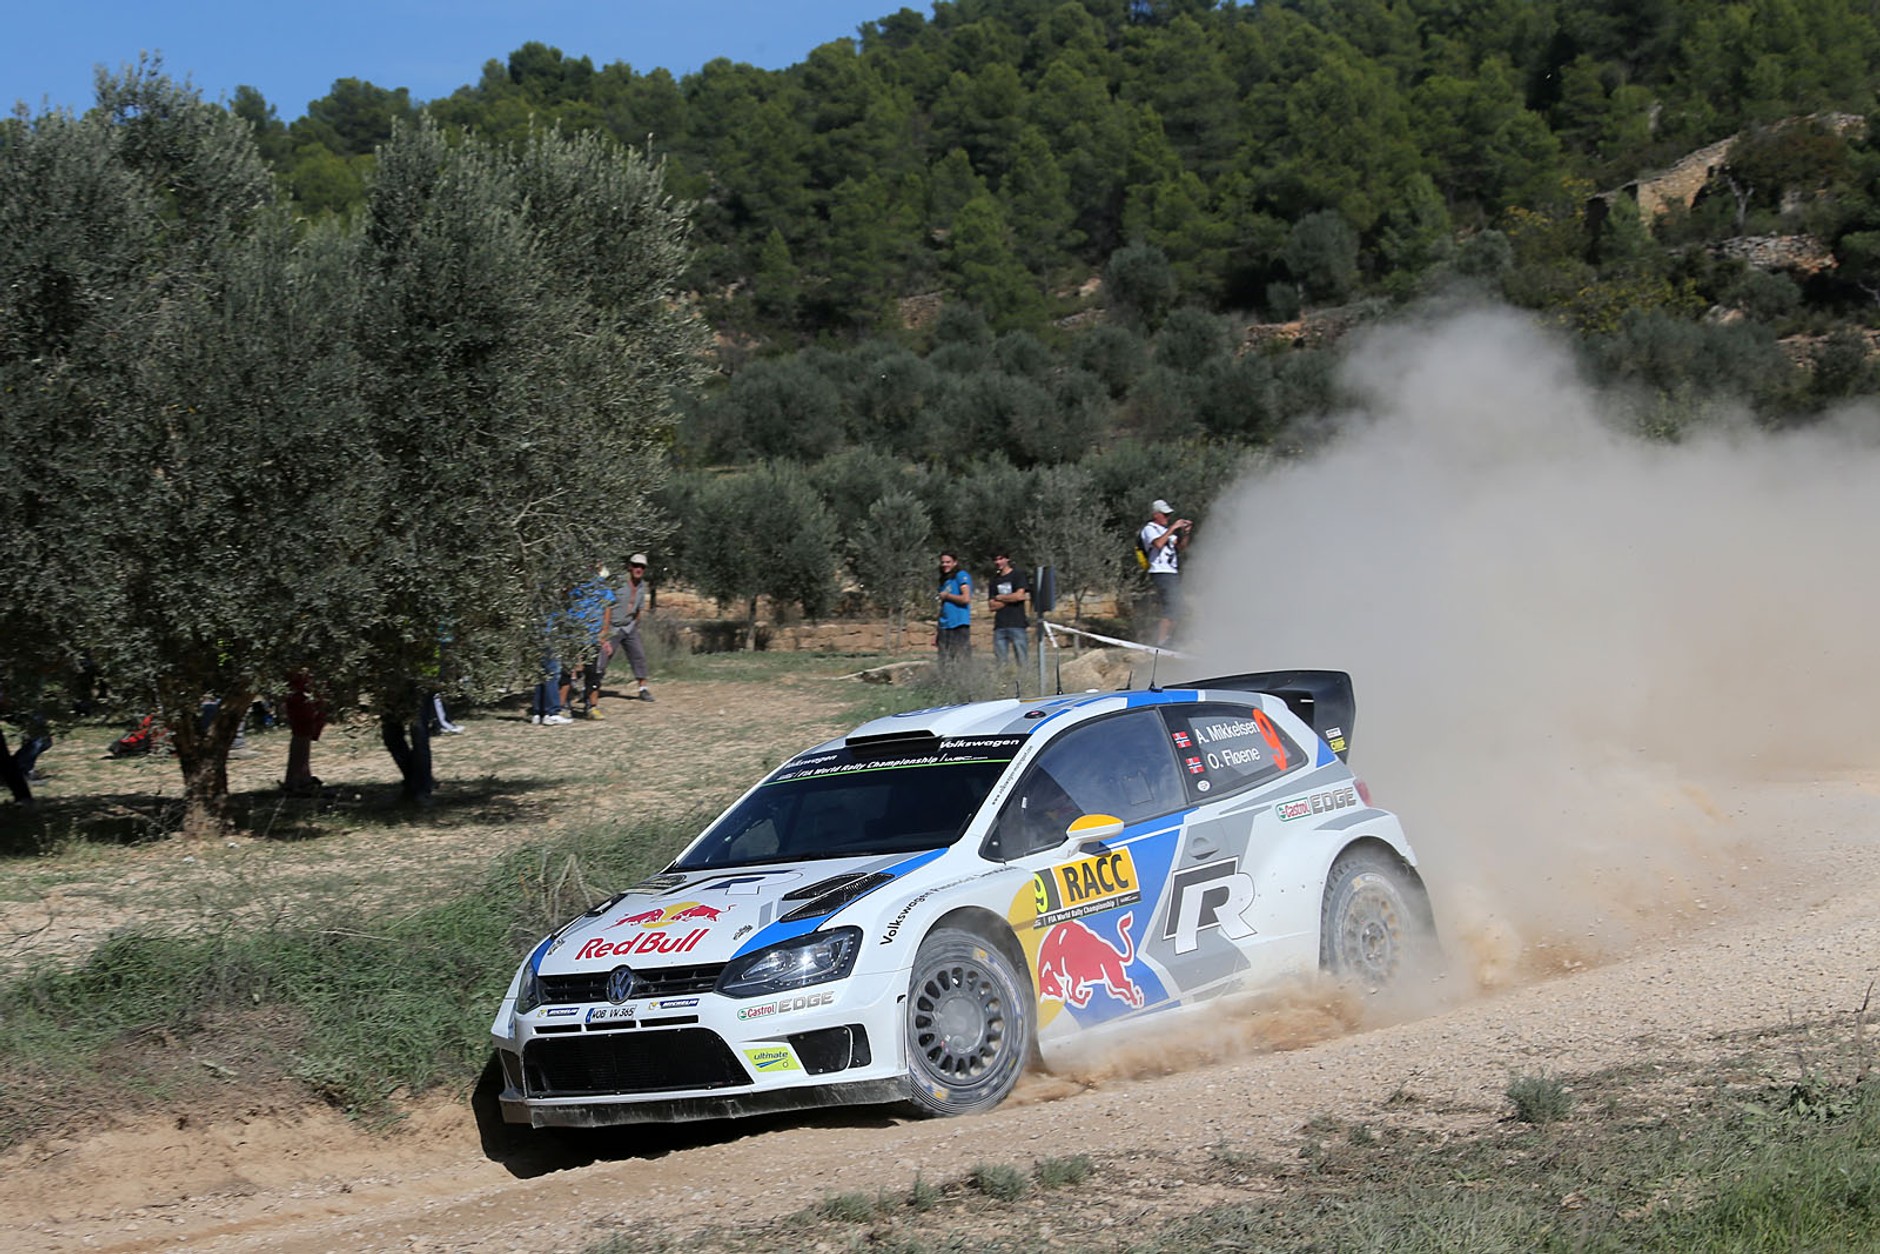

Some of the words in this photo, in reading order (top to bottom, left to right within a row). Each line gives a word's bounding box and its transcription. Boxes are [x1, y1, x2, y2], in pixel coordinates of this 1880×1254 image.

[940, 739, 1020, 750] Volkswagen
[1194, 728, 1210, 744] A.
[1206, 721, 1261, 742] Mikkelsen
[1252, 707, 1288, 771] 9
[814, 764, 843, 775] World
[841, 761, 867, 772] Rally
[866, 755, 938, 770] Championship
[1207, 752, 1224, 769] O.
[1222, 747, 1261, 767] Fløene
[1284, 800, 1311, 818] Castrol
[1310, 786, 1357, 815] EDGE
[1062, 853, 1129, 902] RACC
[1033, 871, 1049, 913] 9
[879, 891, 932, 946] Volkswagen
[1057, 911, 1071, 922] World
[1071, 907, 1083, 919] Rally
[1083, 899, 1116, 915] Championship
[1173, 870, 1258, 956] R
[574, 932, 645, 961] Red
[634, 928, 710, 955] Bull
[591, 1010, 607, 1020] WOB
[619, 1007, 635, 1017] 365
[747, 1004, 775, 1018] Castrol
[778, 990, 835, 1013] EDGE
[753, 1050, 789, 1060] ultimate
